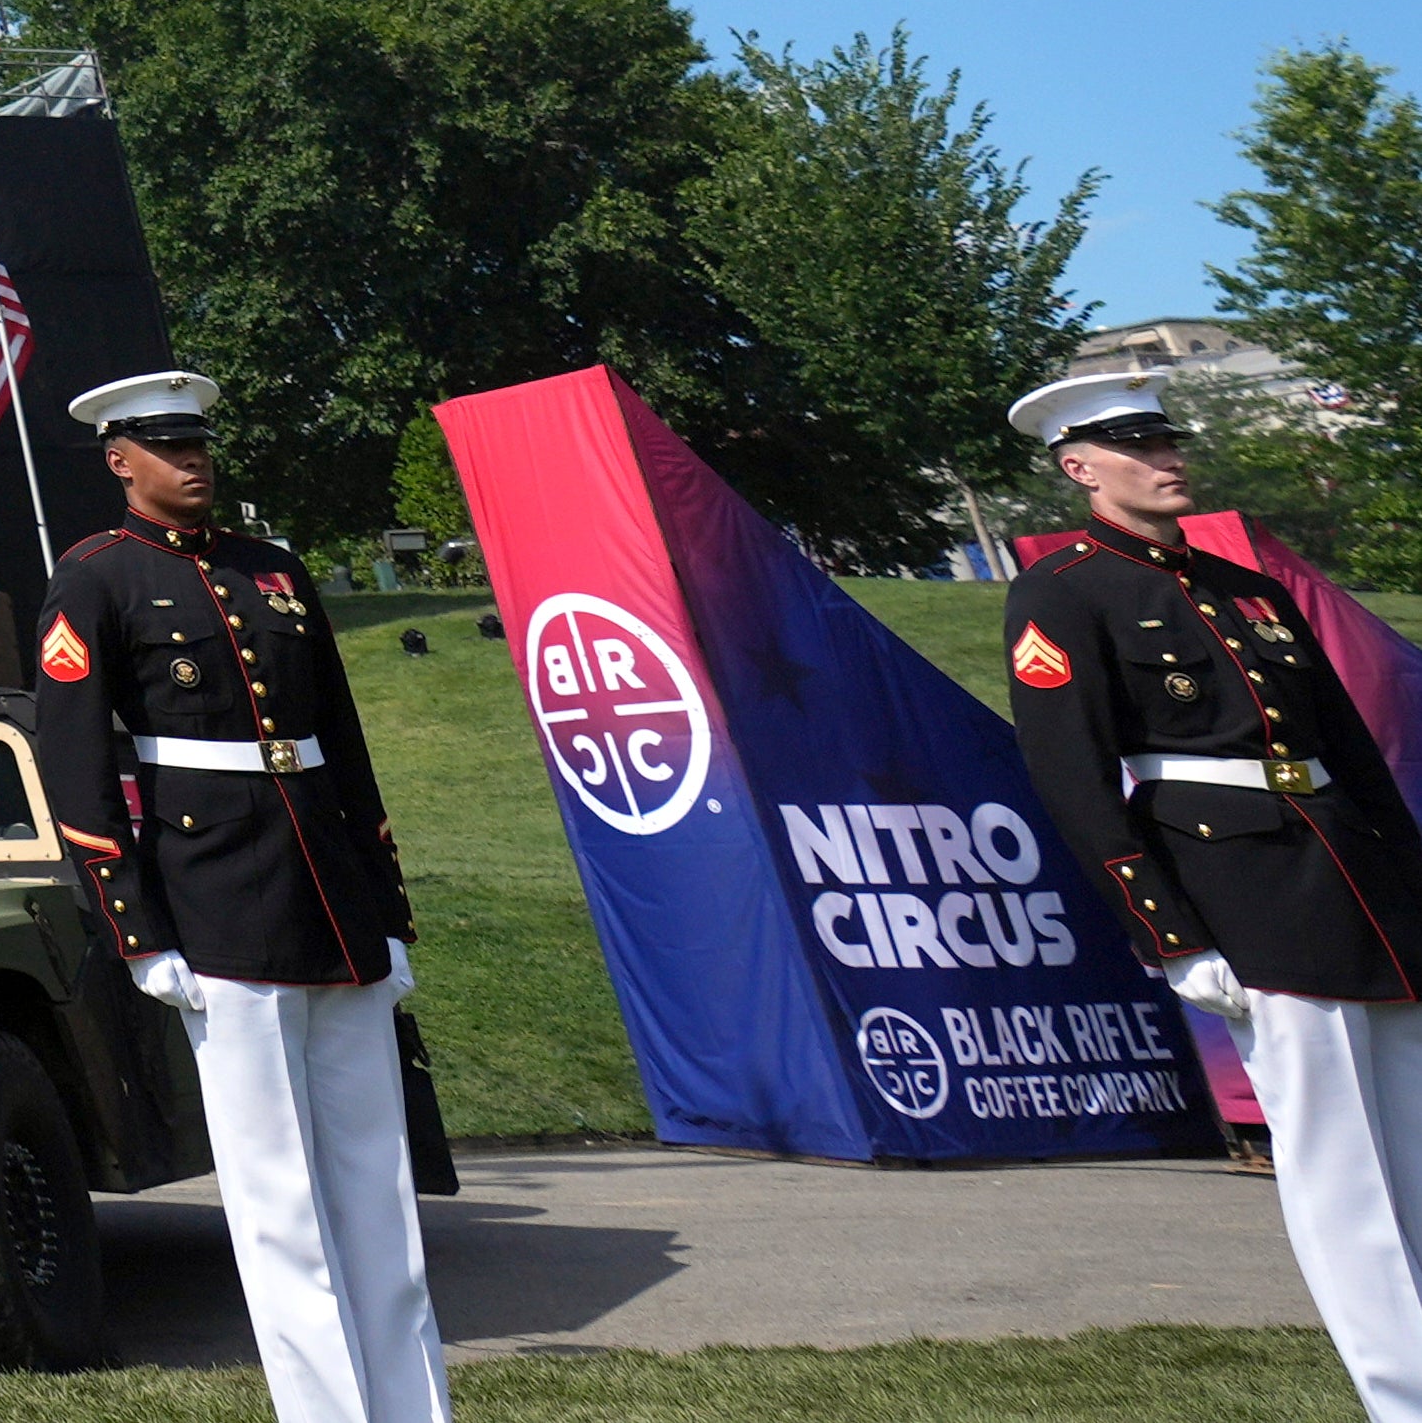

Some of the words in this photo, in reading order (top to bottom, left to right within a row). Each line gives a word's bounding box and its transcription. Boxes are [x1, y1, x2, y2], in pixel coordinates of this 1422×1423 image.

[778, 802, 1041, 884] NITRO
[811, 890, 1078, 968] CIRCUS
[939, 1004, 1072, 1066] BLACK
[1062, 1002, 1174, 1063] RIFLE
[963, 1075, 1071, 1120] COFFEE
[1067, 1070, 1188, 1116] COMPANY
